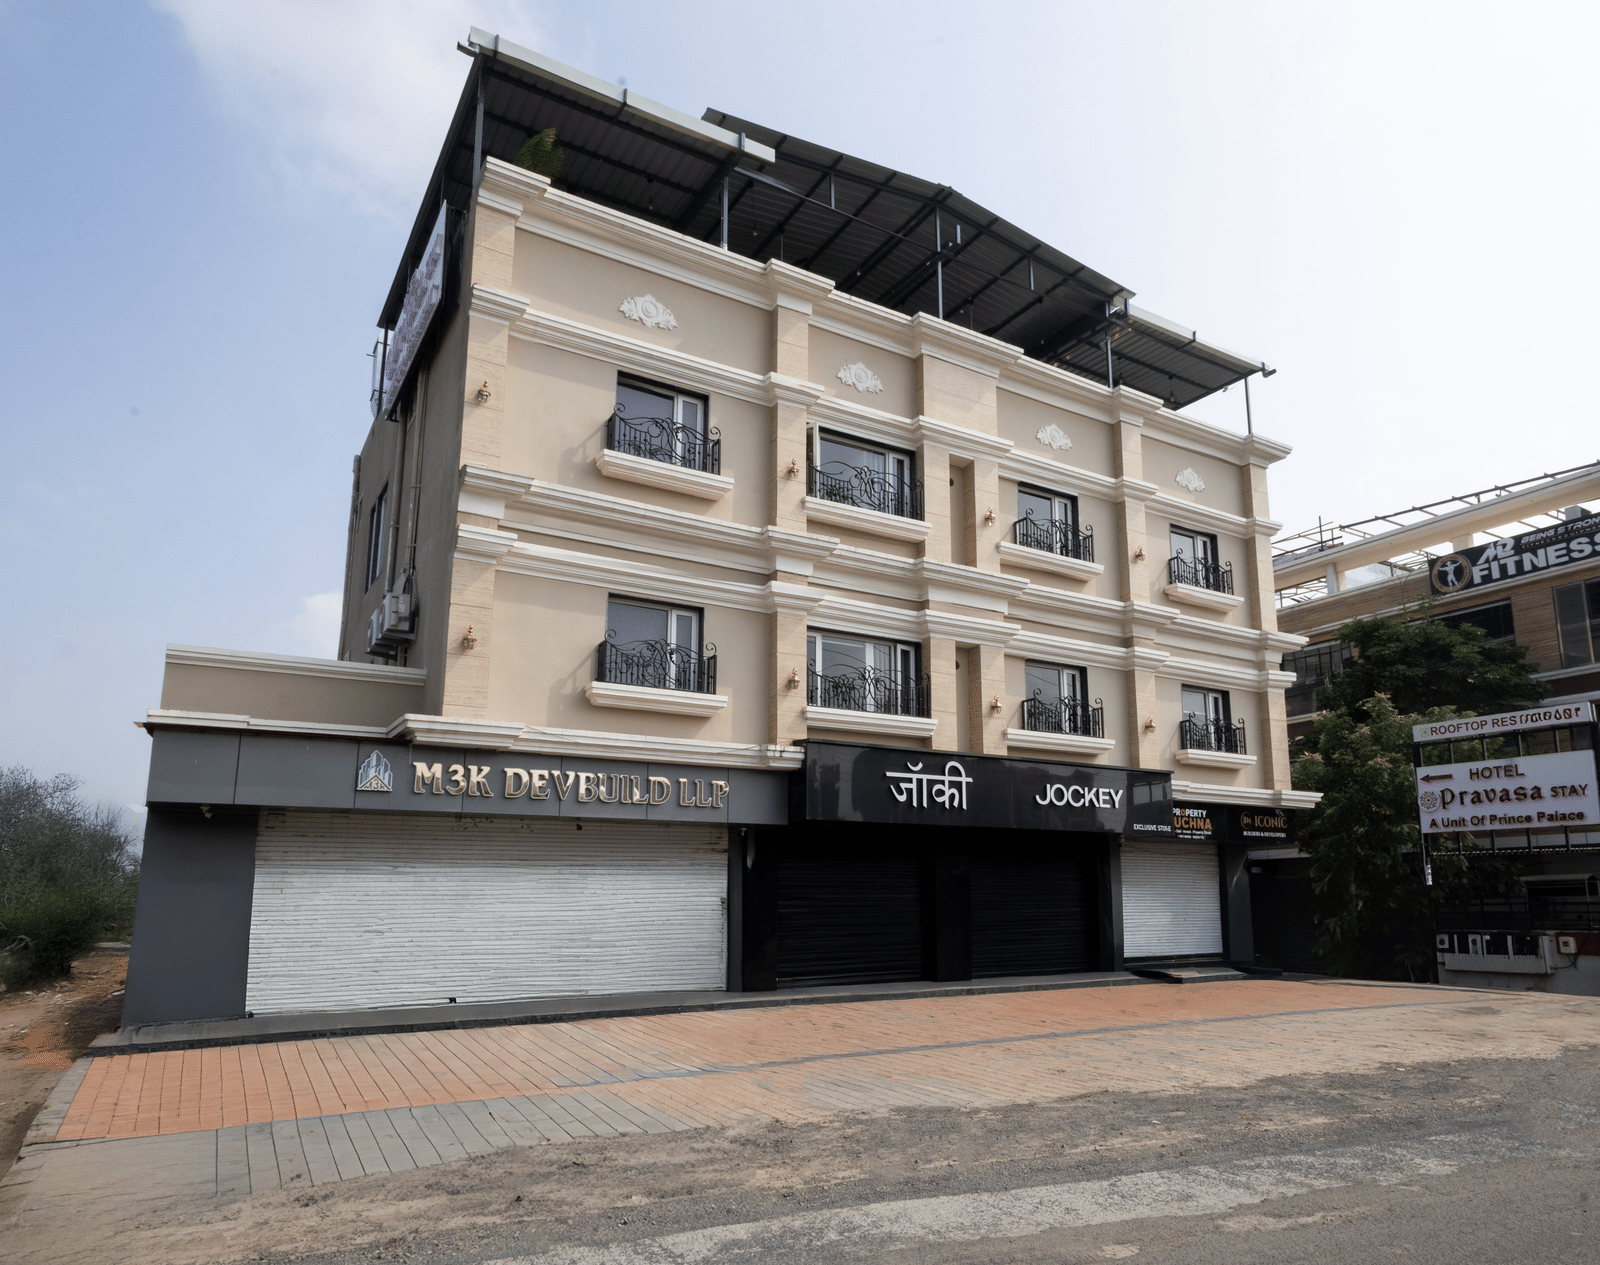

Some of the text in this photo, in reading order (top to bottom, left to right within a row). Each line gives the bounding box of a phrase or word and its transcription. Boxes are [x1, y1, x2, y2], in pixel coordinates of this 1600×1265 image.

[1521, 528, 1555, 544] BEING
[1430, 719, 1488, 736] ROOFTOP
[1469, 764, 1525, 781] HOTEL
[412, 761, 730, 808] M3K DEVBUILD LLP
[885, 760, 974, 810] जॉकी
[1550, 783, 1588, 798] STAY
[1036, 783, 1123, 809] JOCKEY
[1254, 815, 1288, 829] ICONIC
[1429, 810, 1586, 829] A Unit Of Prince Palace
